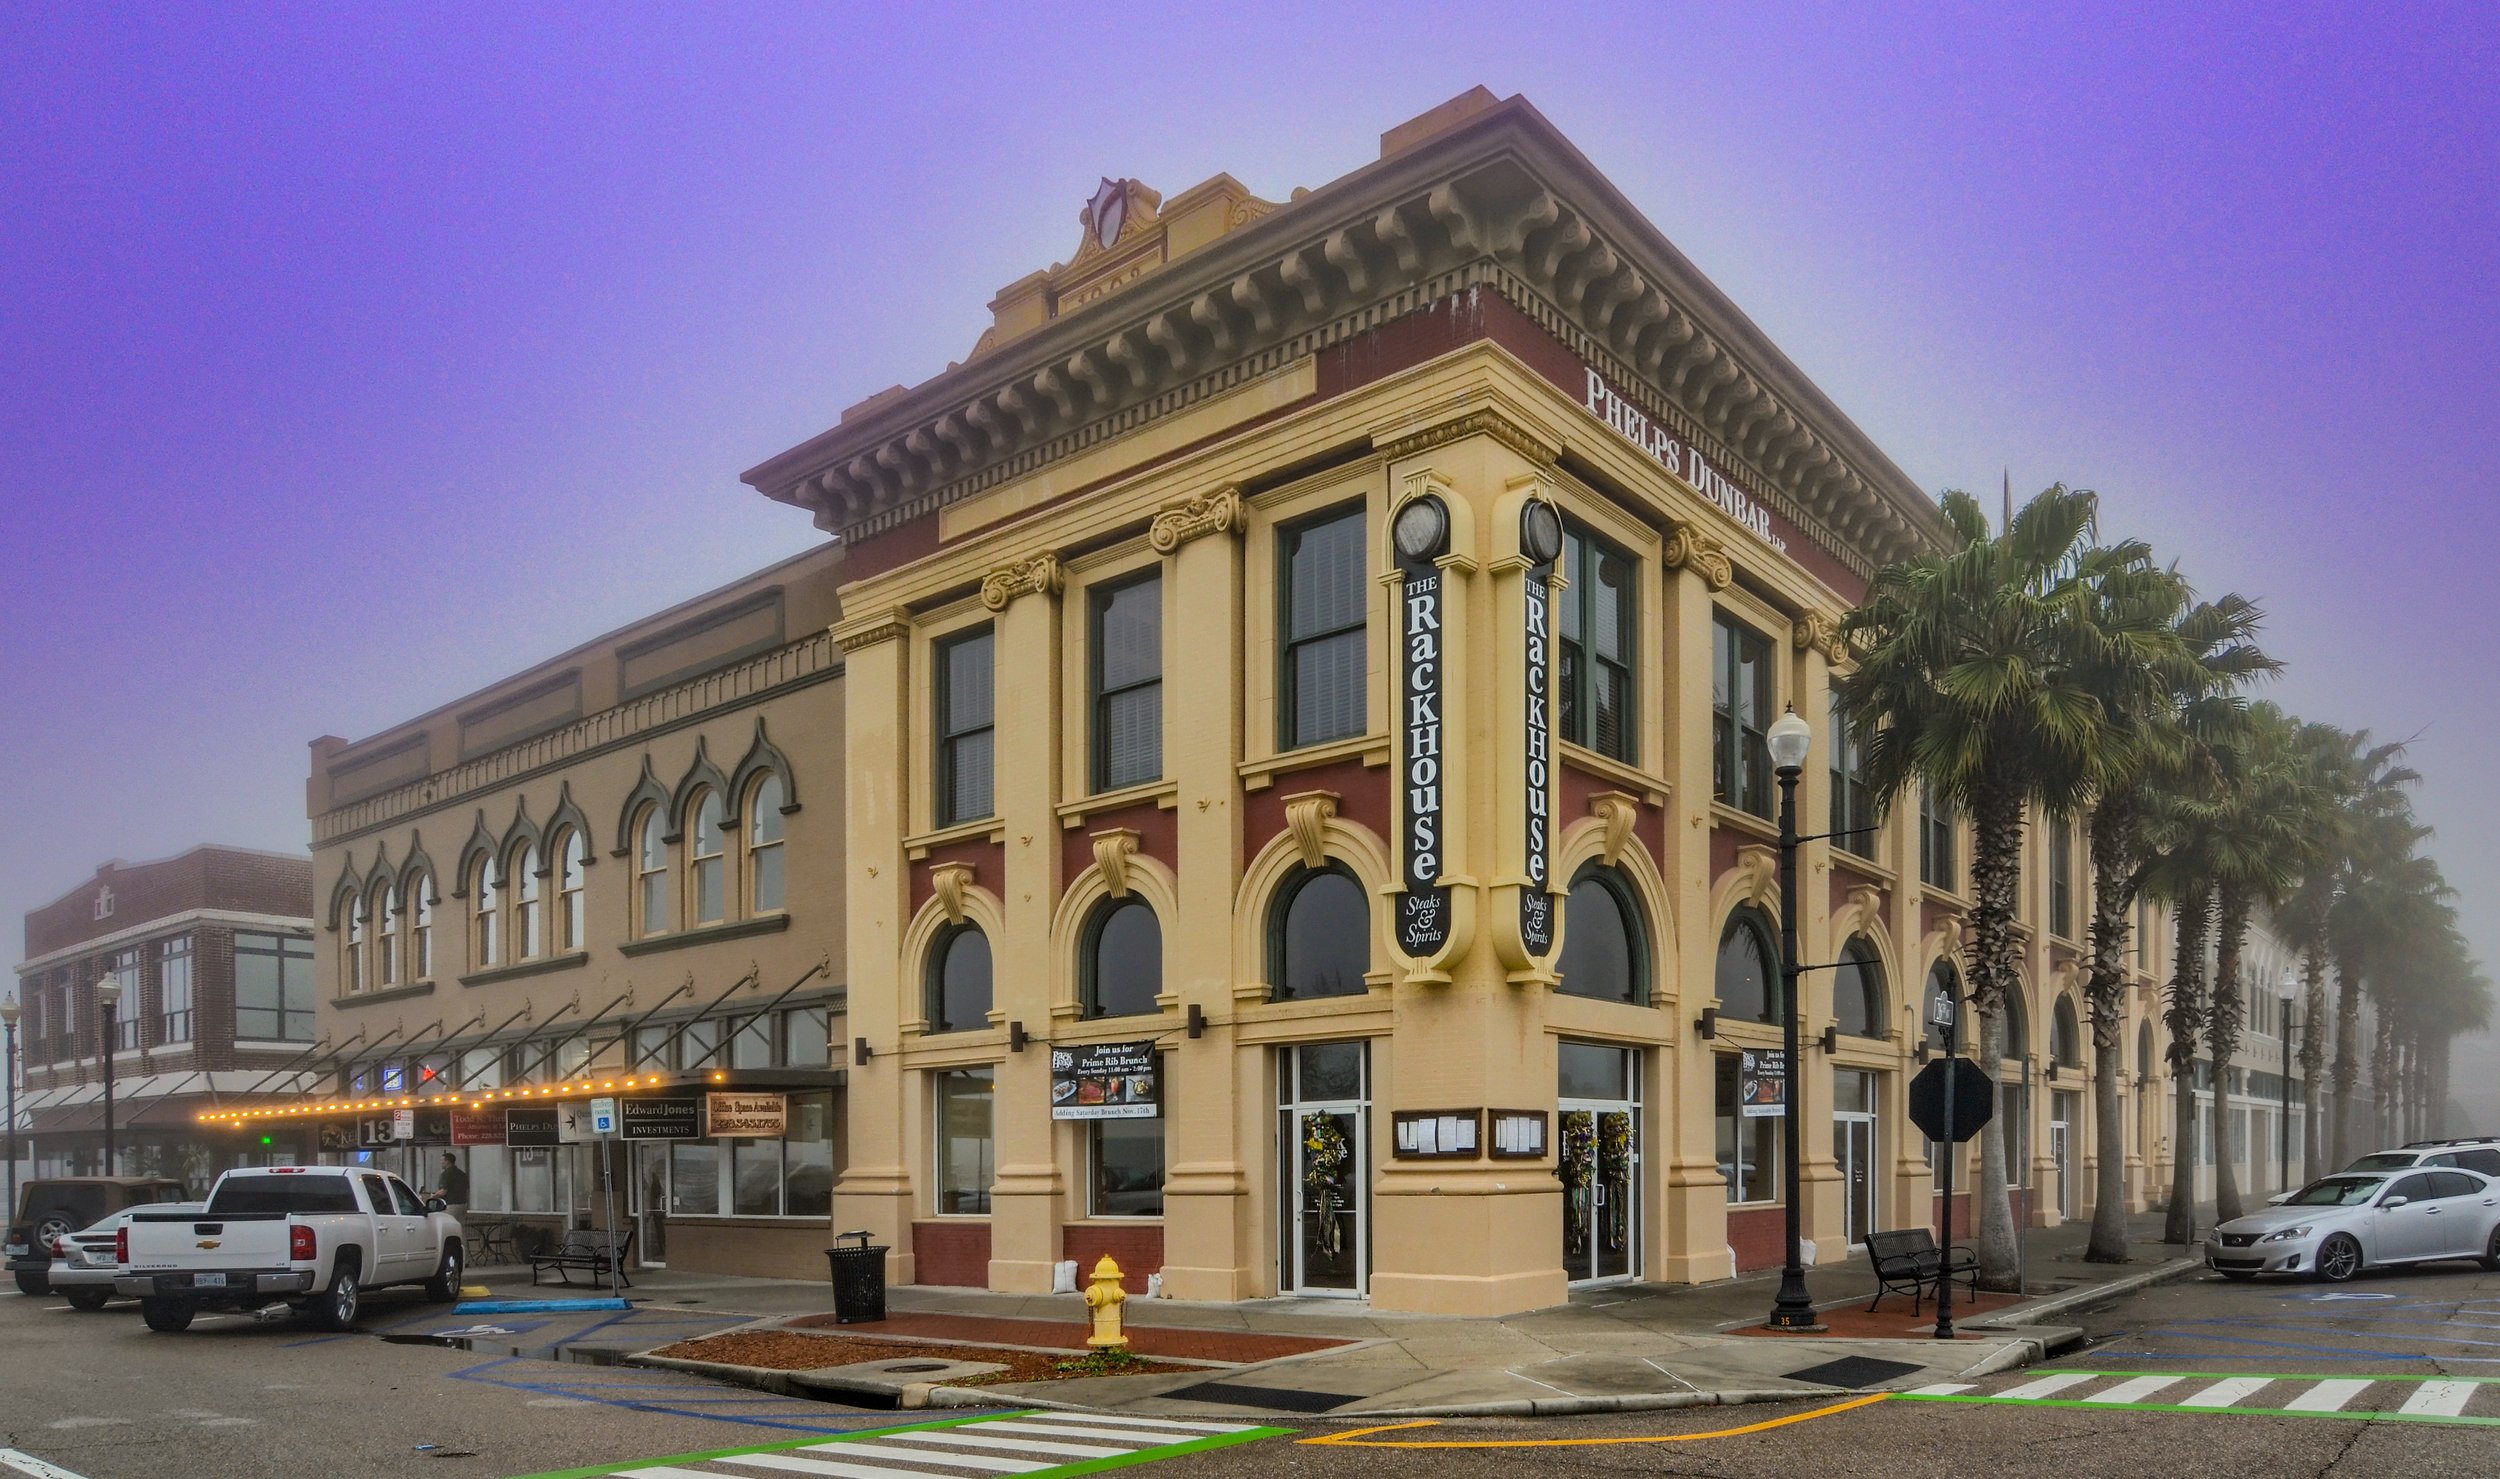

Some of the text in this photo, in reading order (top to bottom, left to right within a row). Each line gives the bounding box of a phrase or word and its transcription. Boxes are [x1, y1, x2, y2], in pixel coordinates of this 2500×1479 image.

[1584, 367, 1680, 474] PHELPS
[1687, 446, 1771, 542] DUNBAR
[1406, 576, 1437, 596] THE
[1525, 578, 1546, 599] THE
[1406, 894, 1441, 916] Steaks
[1524, 893, 1547, 912] Steaks
[1417, 909, 1436, 929] &
[1532, 910, 1544, 929] &
[1406, 923, 1442, 948] Spirits
[1525, 921, 1548, 946] Spirits
[1094, 1045, 1111, 1057] Join
[1122, 1044, 1134, 1053] for
[1082, 1055, 1148, 1067] Prime Rib Brunch
[1091, 1067, 1107, 1075] Sunday
[713, 1101, 782, 1114] Office Space Available
[364, 1119, 396, 1144] 13
[510, 1122, 539, 1131] PHELPS
[633, 1126, 690, 1135] INVESTMENTS
[1780, 1316, 1790, 1325] 35
